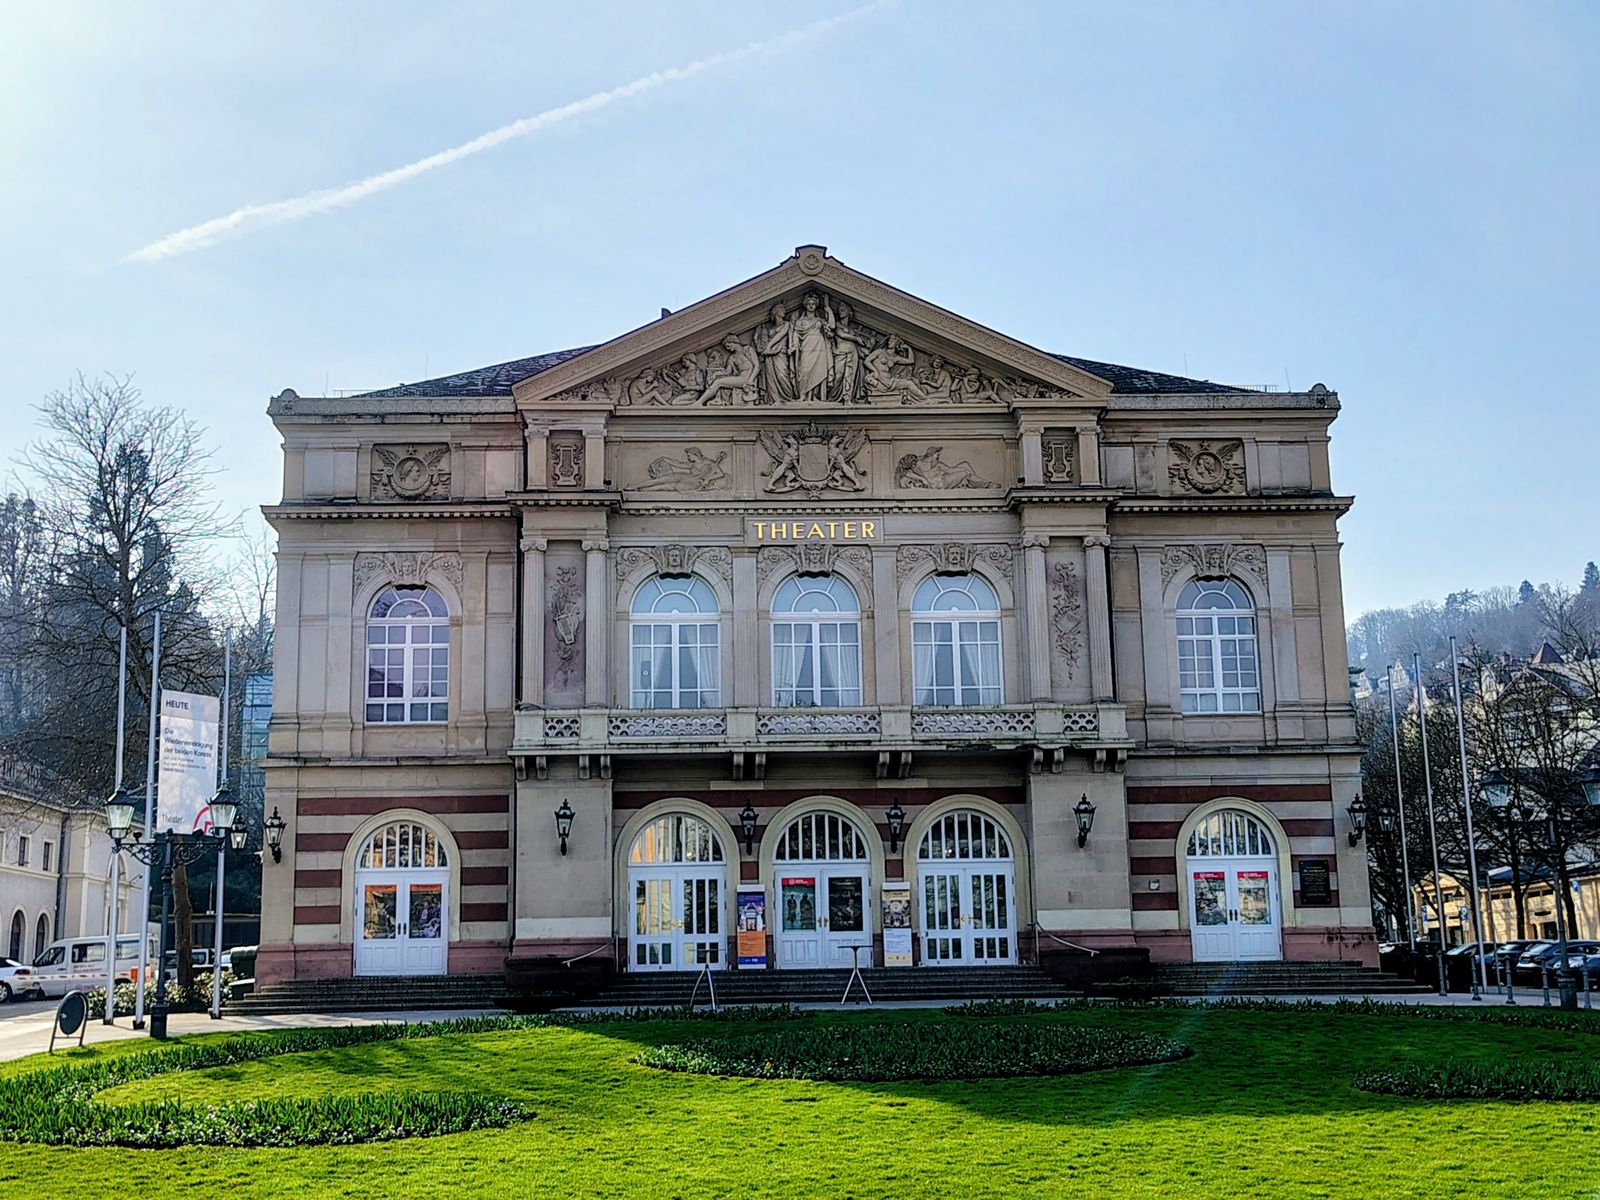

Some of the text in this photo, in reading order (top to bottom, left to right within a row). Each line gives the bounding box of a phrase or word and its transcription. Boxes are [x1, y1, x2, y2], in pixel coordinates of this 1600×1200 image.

[752, 521, 877, 540] THEATER
[165, 700, 189, 710] HEUTE
[161, 814, 184, 824] Theater
